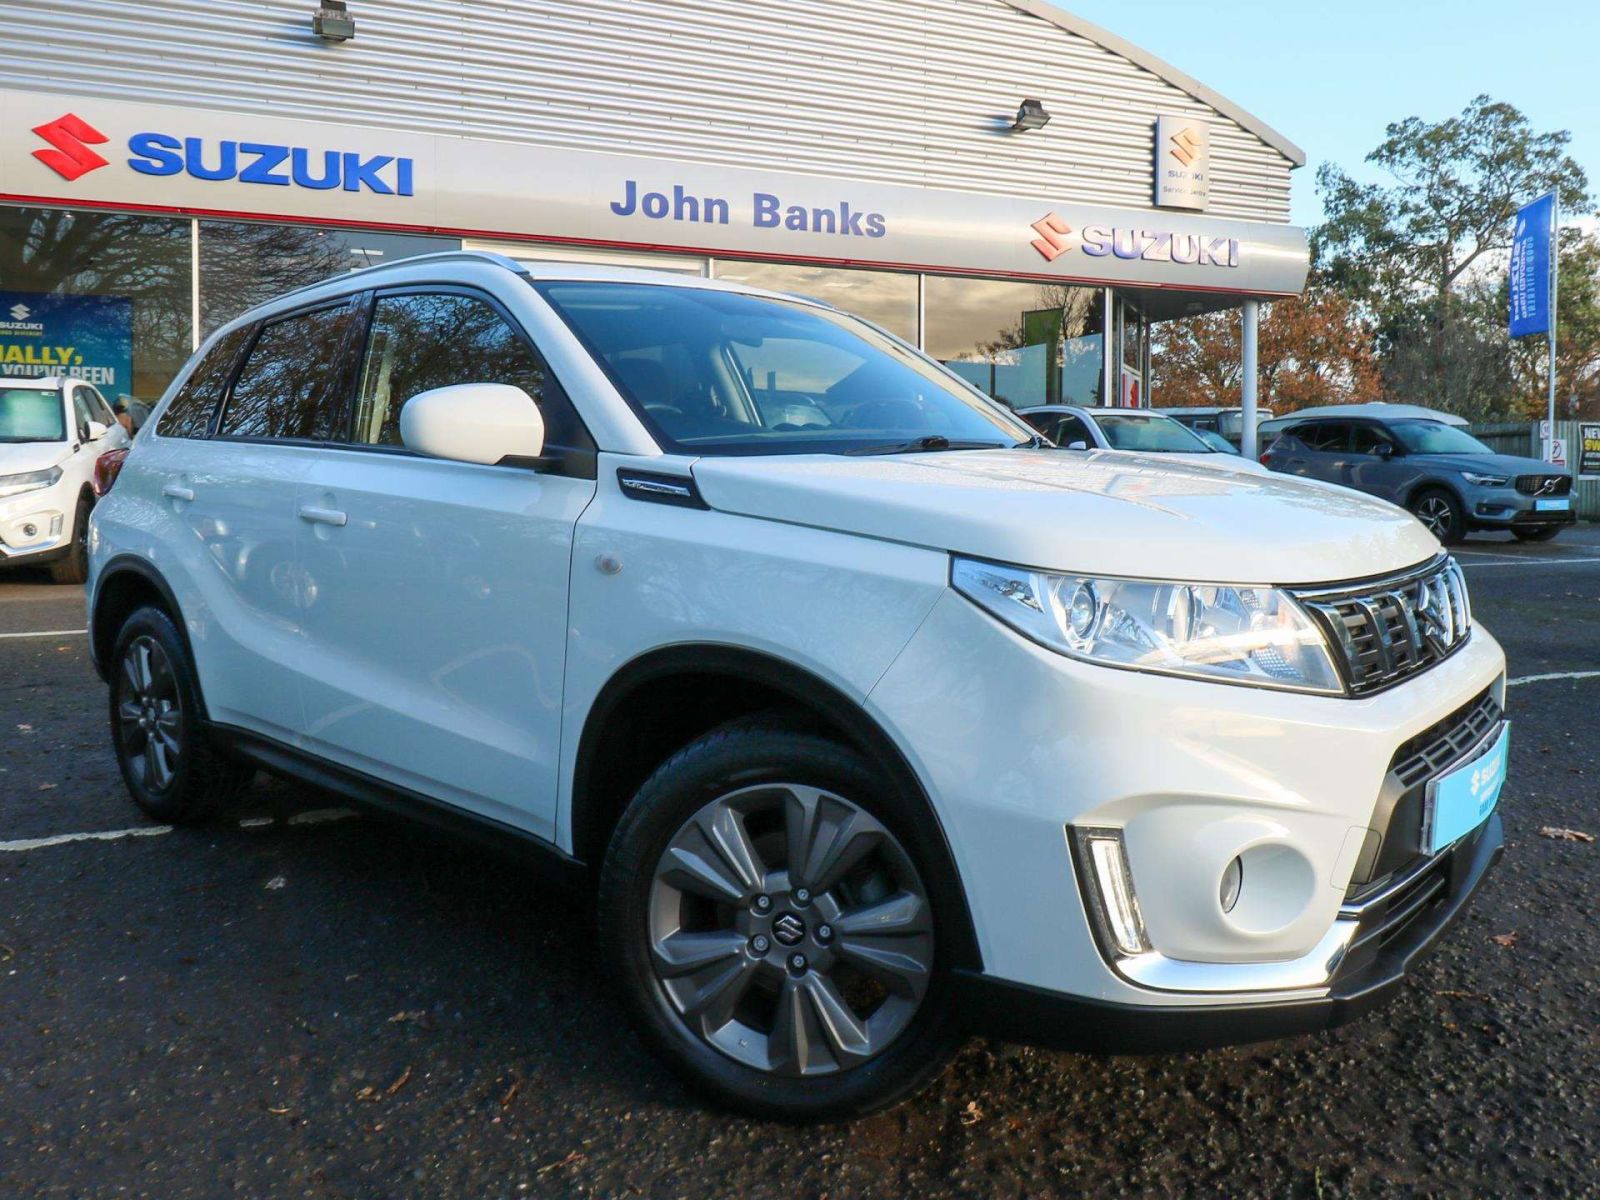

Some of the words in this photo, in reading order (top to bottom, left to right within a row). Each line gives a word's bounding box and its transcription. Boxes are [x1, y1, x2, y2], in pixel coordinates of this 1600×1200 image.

[128, 132, 413, 197] SUZUKI
[1168, 170, 1204, 181] SUKI
[610, 180, 729, 225] John
[753, 192, 887, 238] Banks
[1081, 223, 1239, 267] SUZUKI
